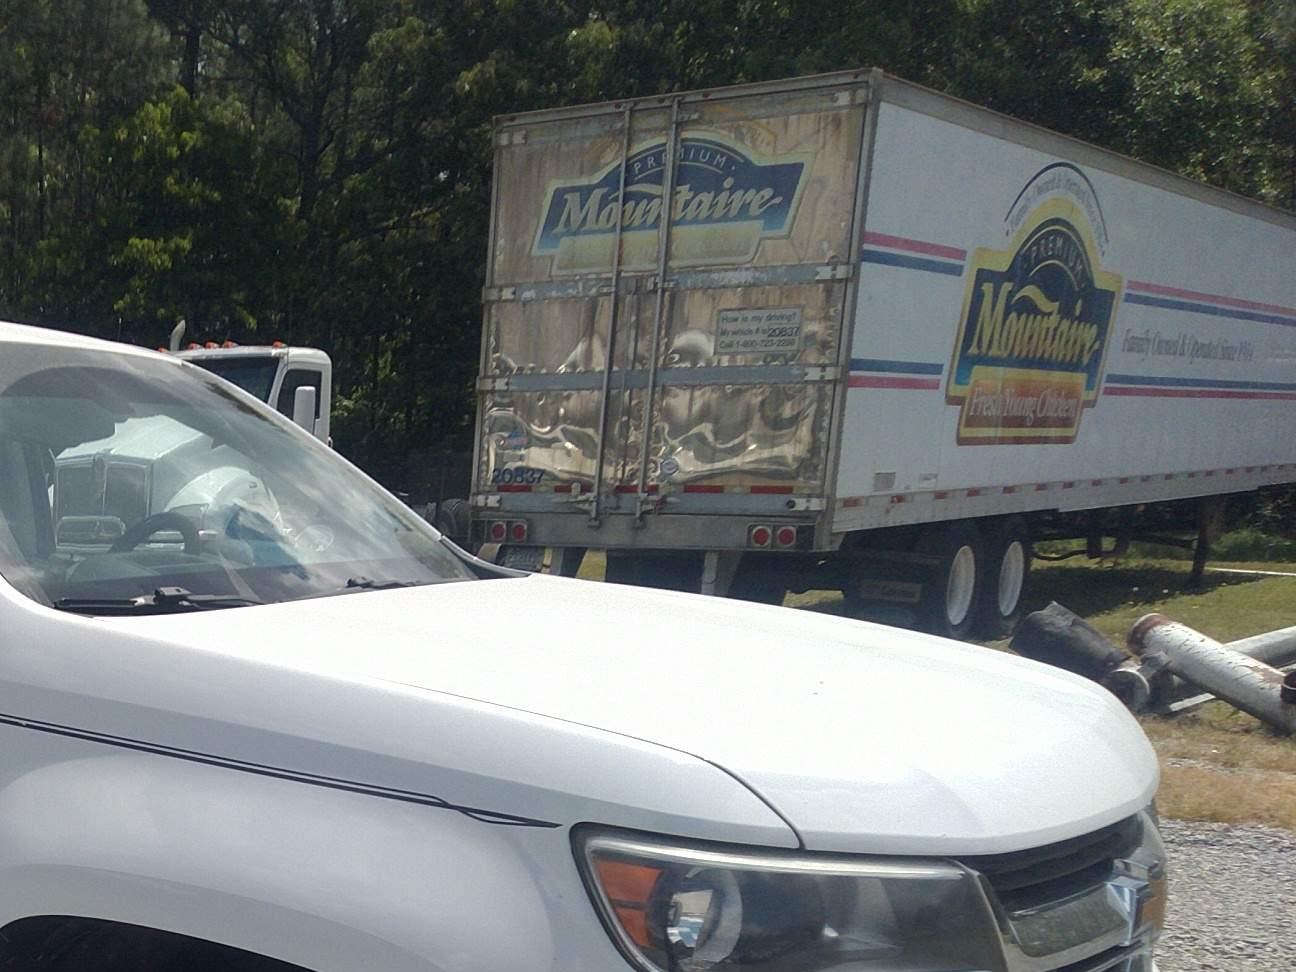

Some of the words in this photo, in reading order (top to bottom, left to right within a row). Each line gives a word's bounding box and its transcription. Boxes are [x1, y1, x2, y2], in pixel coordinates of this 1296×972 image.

[552, 177, 783, 234] Mountaire
[1030, 234, 1084, 274] PREMIUM
[720, 314, 739, 323] How
[751, 314, 764, 324] my
[766, 311, 797, 323] driving?
[967, 282, 1100, 366] Mountaire
[969, 386, 1001, 417] Fresh
[1003, 386, 1035, 426] Young
[1037, 389, 1080, 418] Chicken
[491, 467, 545, 485] 20837
